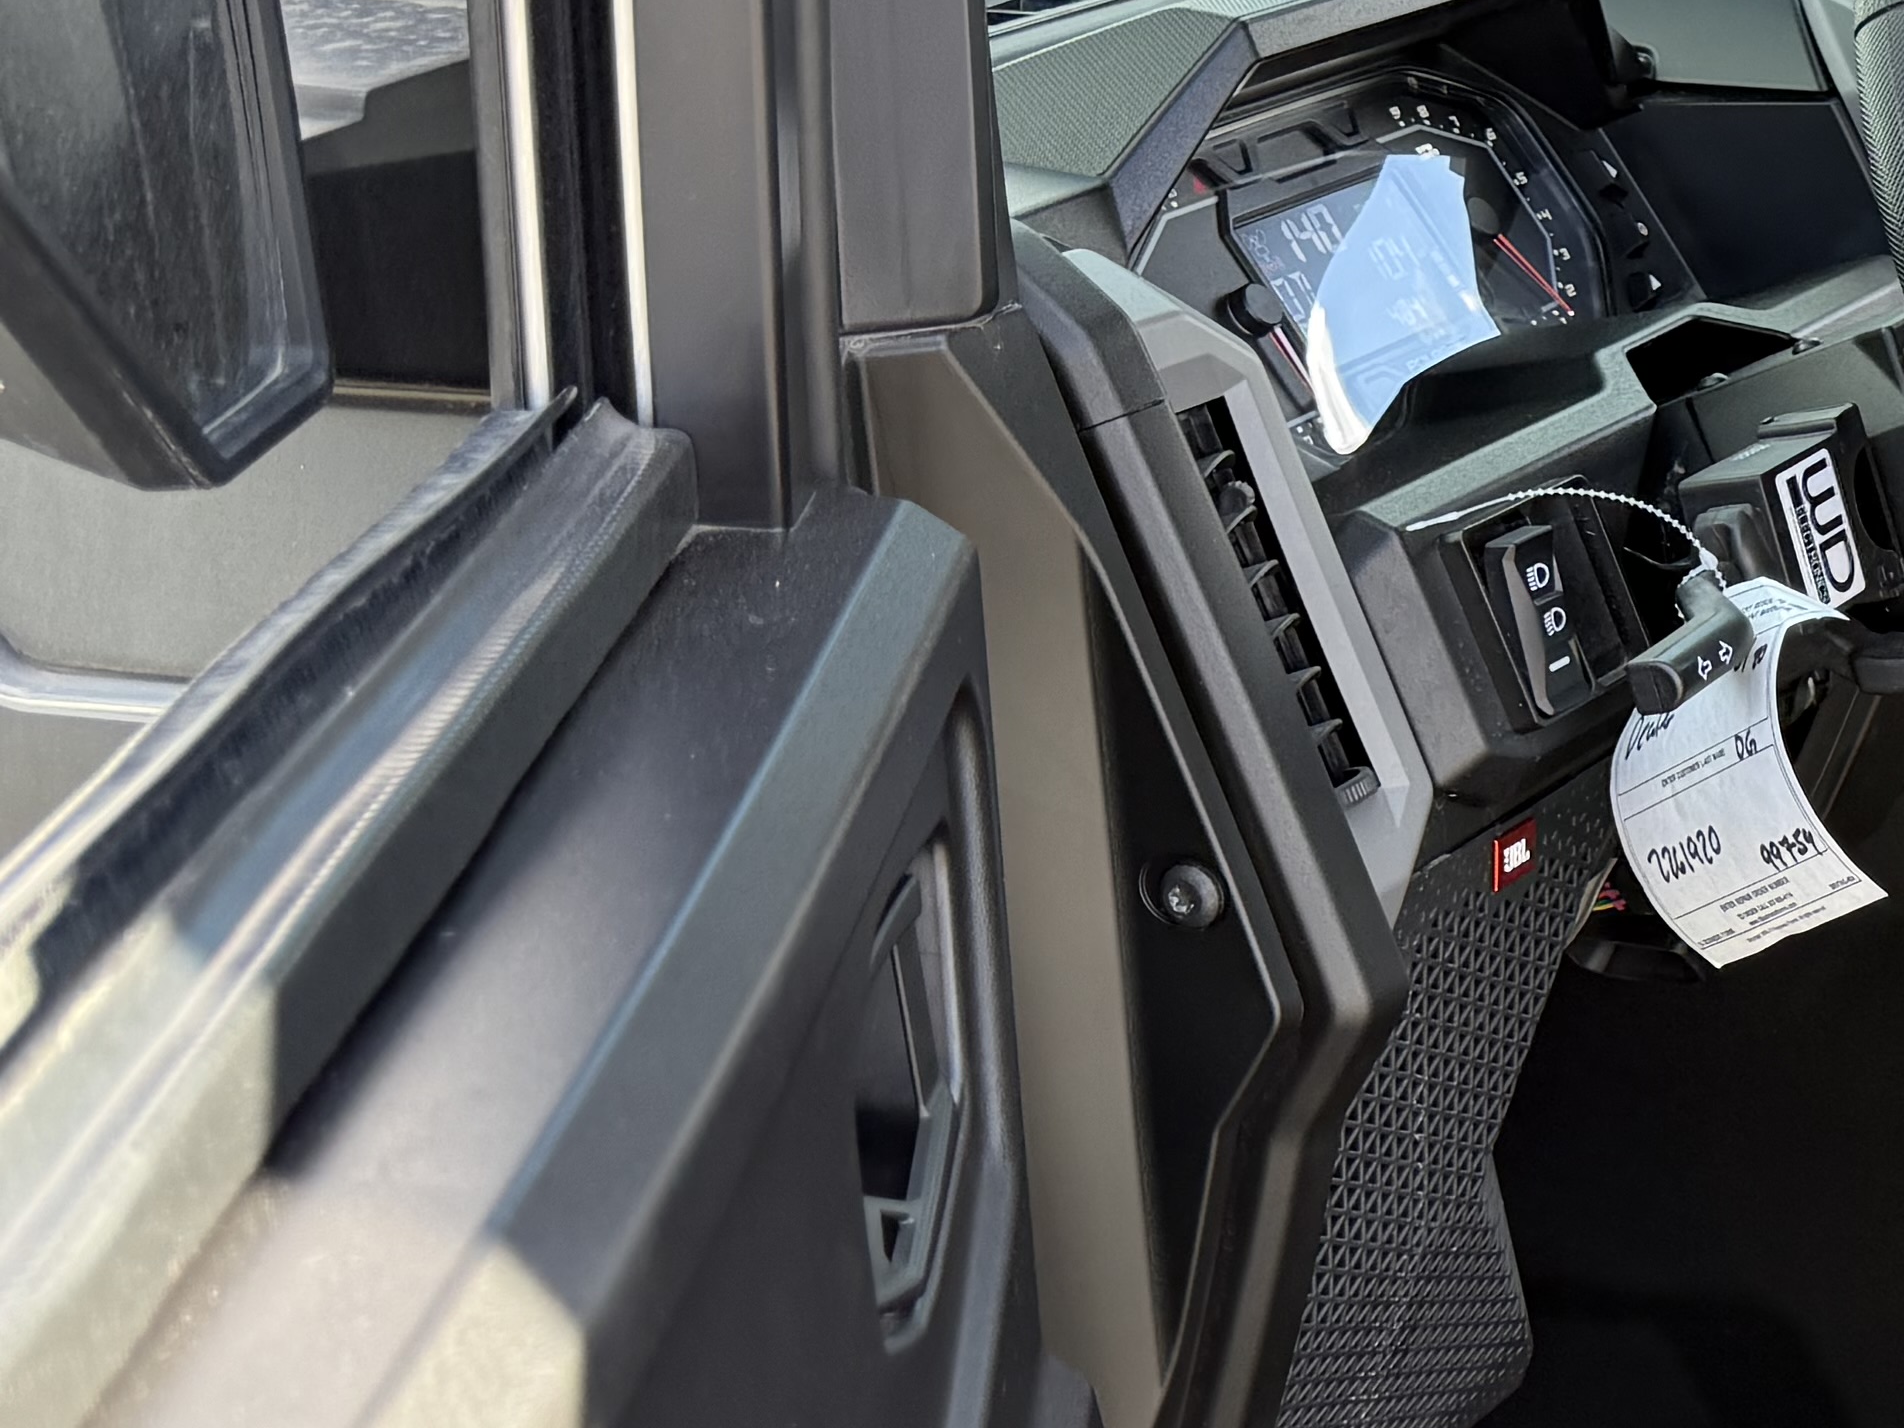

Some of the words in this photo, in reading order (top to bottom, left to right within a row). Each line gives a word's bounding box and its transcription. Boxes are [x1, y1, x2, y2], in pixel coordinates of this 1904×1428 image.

[1416, 104, 1429, 118] 8
[1559, 248, 1571, 260] 3
[1565, 284, 1577, 297] 2
[1796, 504, 1831, 605] ELECTRONICS
[1503, 837, 1531, 873] JBL
